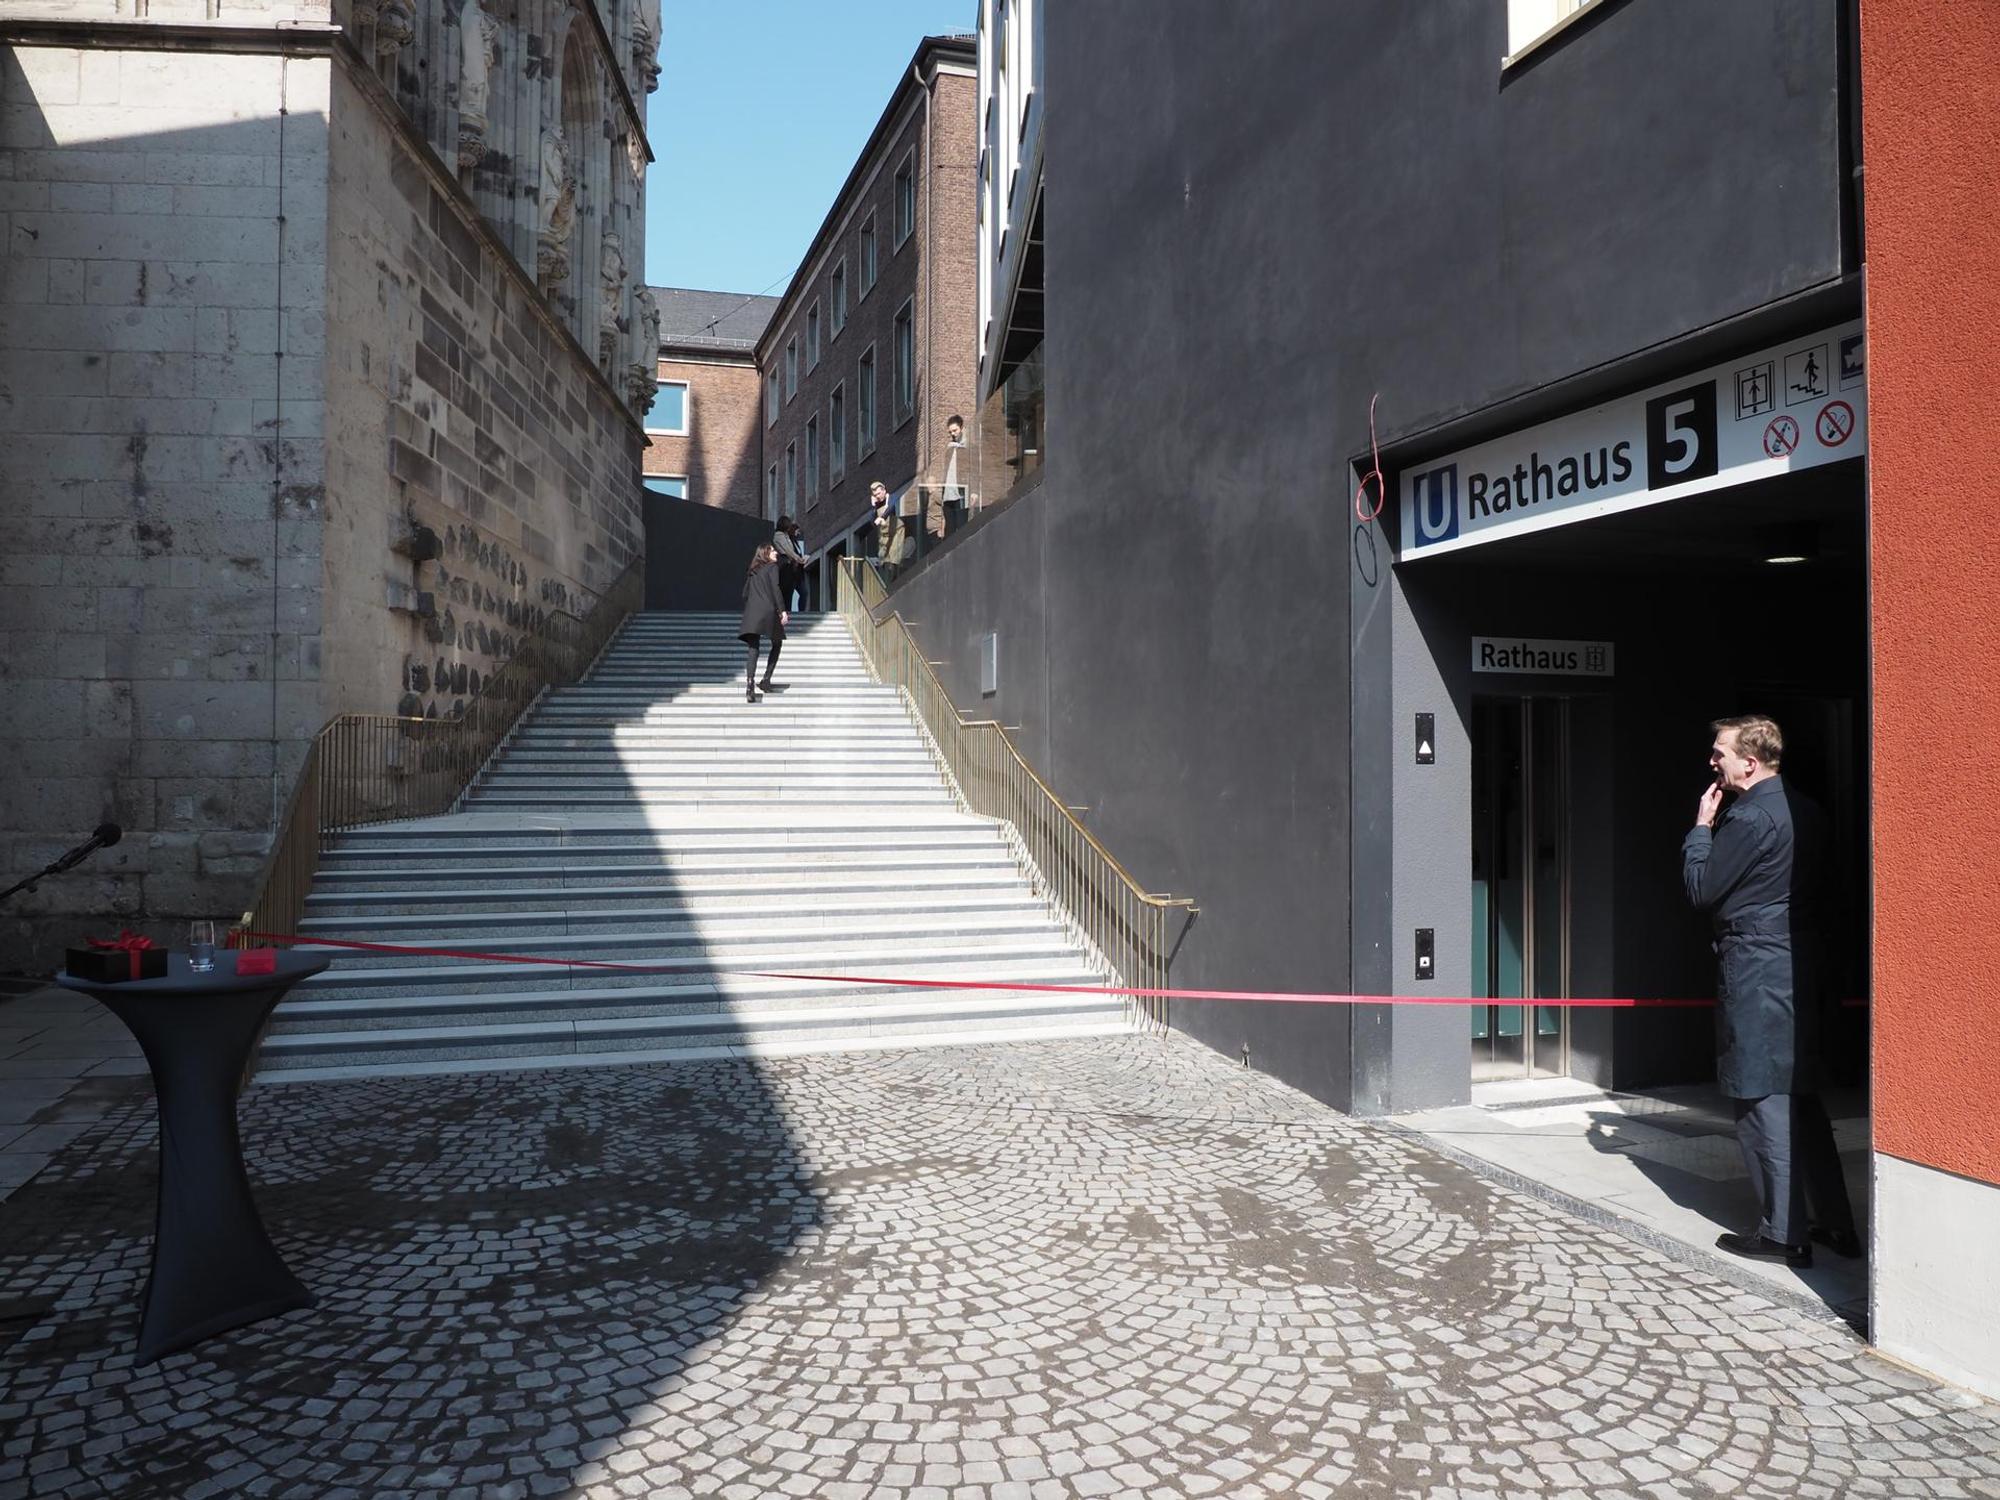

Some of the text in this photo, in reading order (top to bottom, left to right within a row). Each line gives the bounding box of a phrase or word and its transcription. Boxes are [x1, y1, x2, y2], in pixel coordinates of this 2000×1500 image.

[1420, 471, 1450, 539] U
[1468, 441, 1633, 520] Rathaus
[1664, 399, 1699, 474] 5
[1480, 643, 1578, 670] Rathaus
